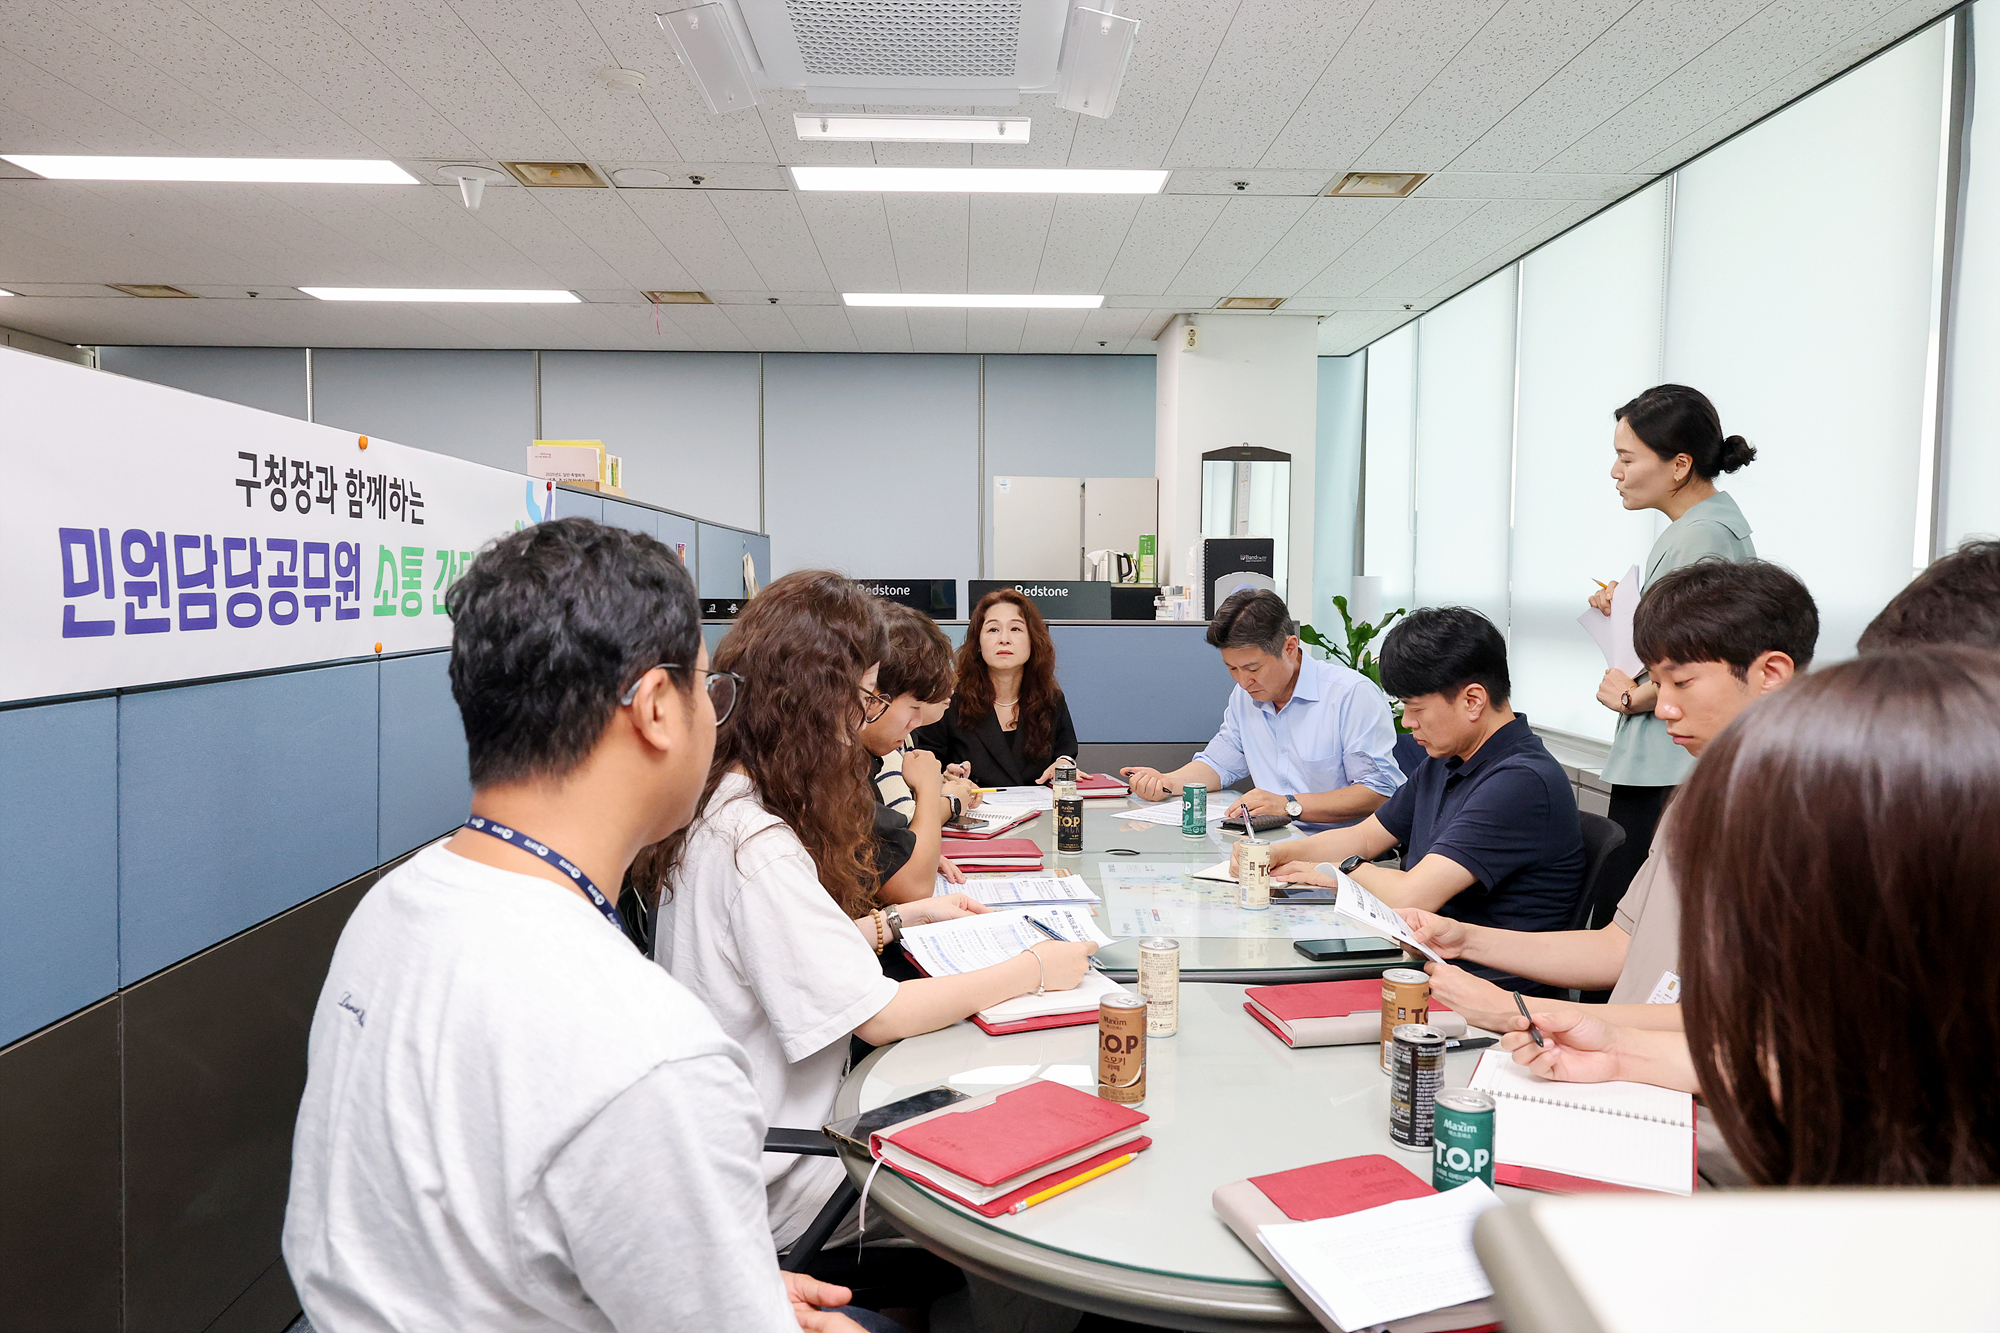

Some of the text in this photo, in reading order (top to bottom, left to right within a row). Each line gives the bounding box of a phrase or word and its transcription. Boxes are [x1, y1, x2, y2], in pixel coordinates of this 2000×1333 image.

[235, 451, 425, 525] 구청장과 함께하는
[58, 527, 476, 638] 민원담당공무원 소통 간
[856, 583, 911, 597] Redstone
[1014, 584, 1069, 597] Redstone
[1103, 1015, 1127, 1026] Maxim
[1103, 1055, 1126, 1066] 스모키
[1443, 1118, 1478, 1134] Maxim
[1434, 1138, 1490, 1173] T.O.P
